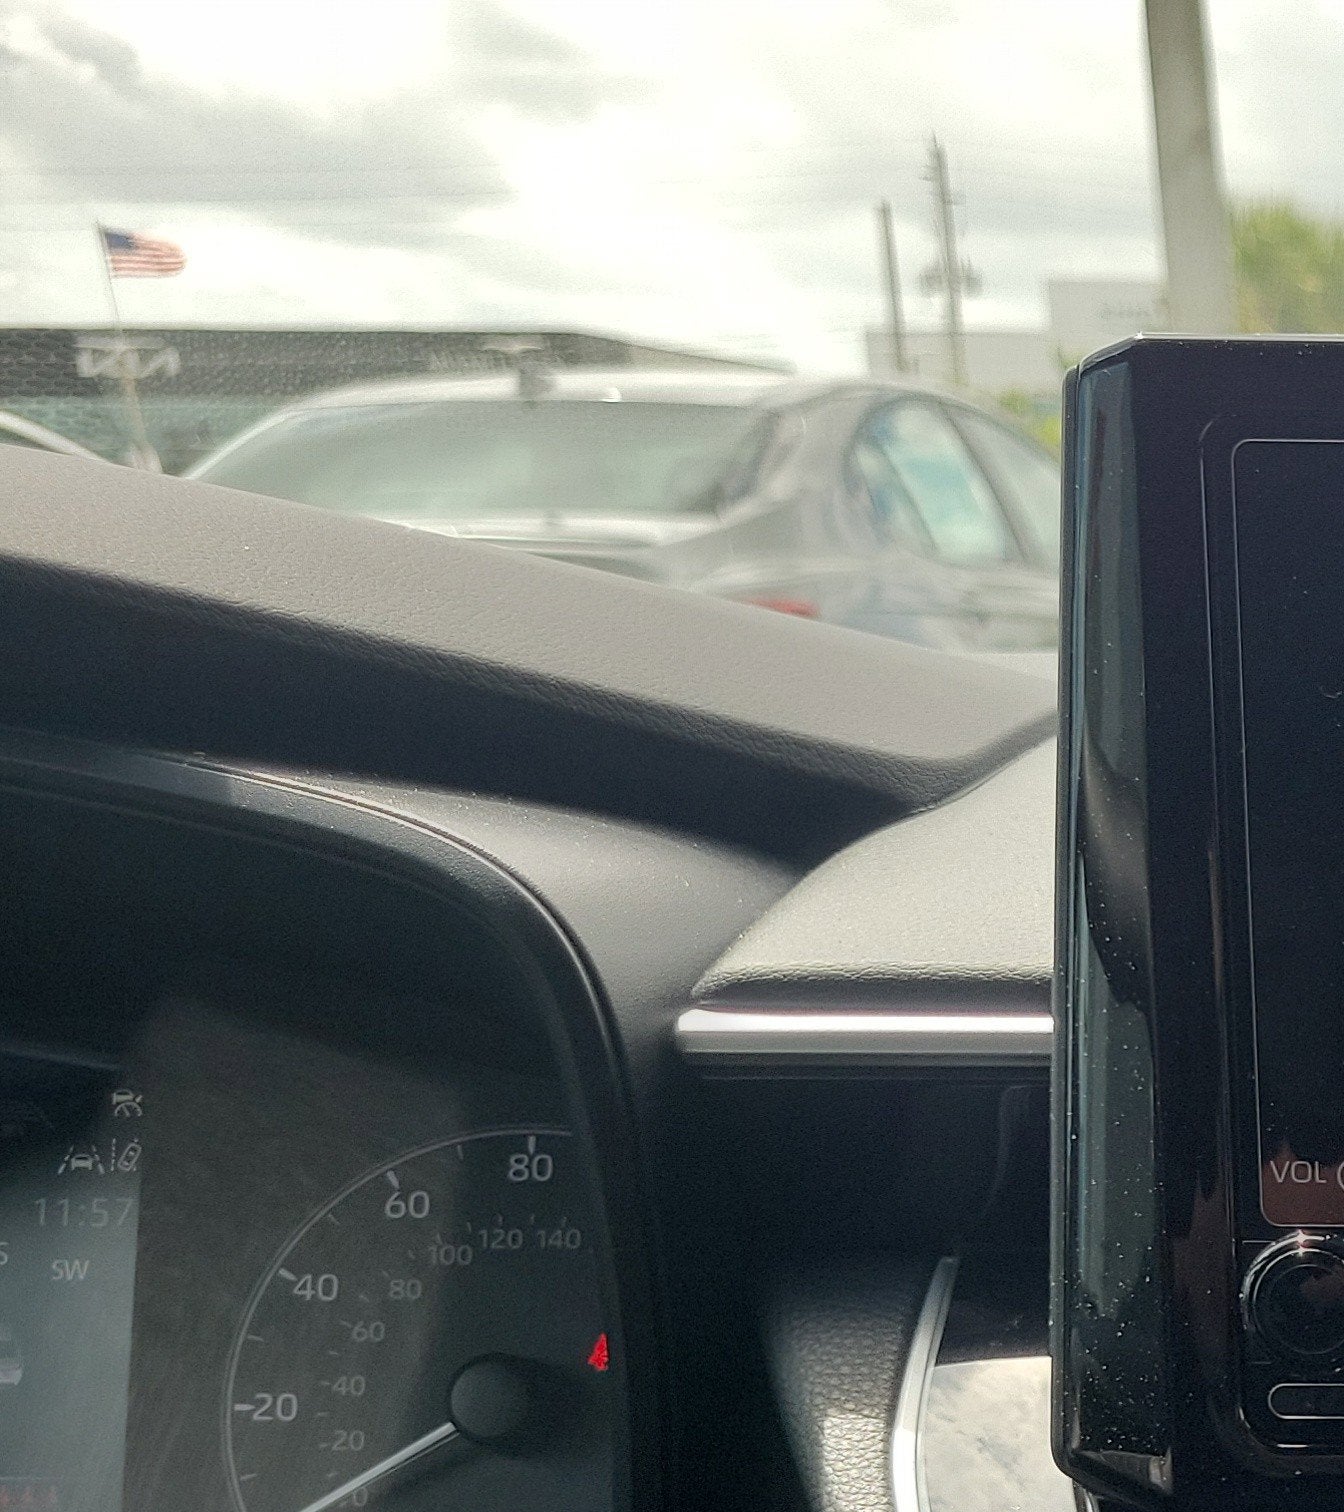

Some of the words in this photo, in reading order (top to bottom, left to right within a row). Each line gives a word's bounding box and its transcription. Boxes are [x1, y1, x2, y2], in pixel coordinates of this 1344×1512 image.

[508, 1153, 553, 1182] 80
[1269, 1160, 1327, 1184] VOL
[384, 1190, 430, 1219] 60
[479, 1227, 523, 1250] 120
[538, 1226, 581, 1250] 140
[428, 1243, 473, 1266] 100
[51, 1259, 90, 1281] SW
[294, 1274, 338, 1301] 40
[388, 1278, 422, 1300] 80
[351, 1320, 385, 1342] 60
[332, 1374, 366, 1396] 40
[253, 1393, 298, 1422] 20
[331, 1429, 365, 1452] 20
